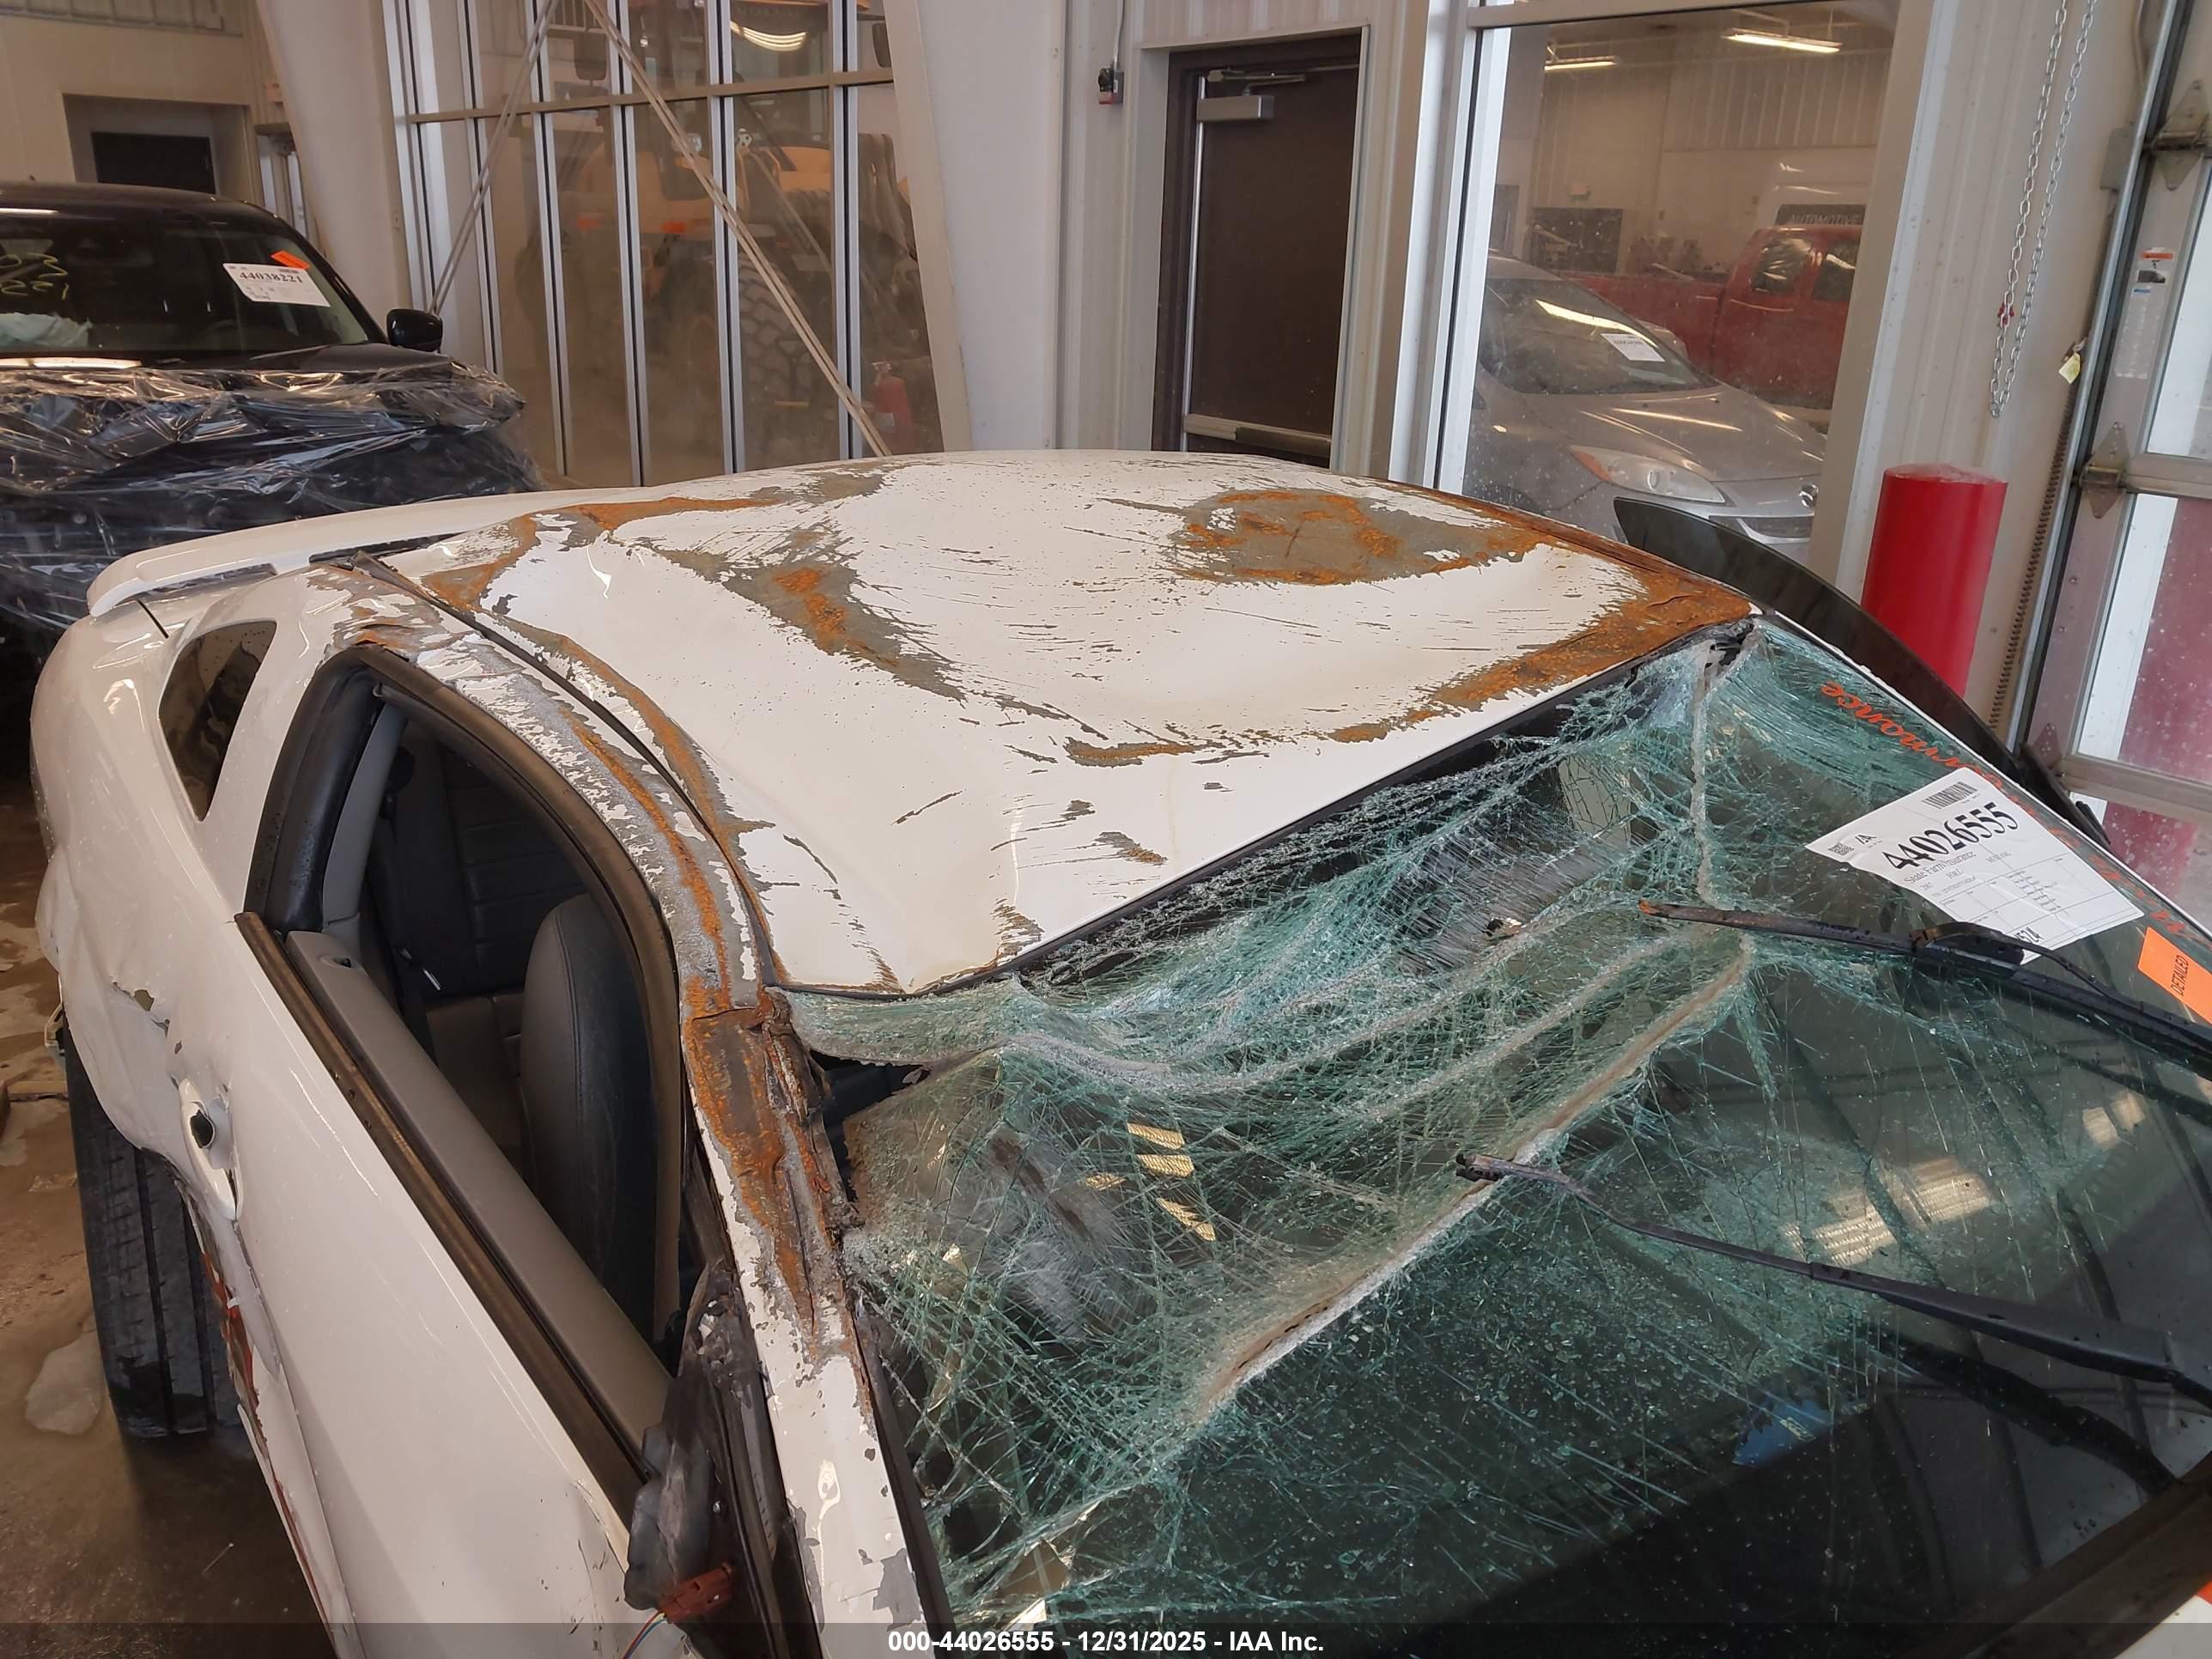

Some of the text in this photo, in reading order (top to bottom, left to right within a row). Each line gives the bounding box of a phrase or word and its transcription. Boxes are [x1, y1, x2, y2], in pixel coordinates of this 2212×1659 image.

[240, 271, 303, 283] 44038221
[1882, 802, 2019, 871] 44026555
[1904, 872, 1928, 884] State
[1923, 861, 1947, 874] Farm
[2170, 954, 2189, 997] DETAILED
